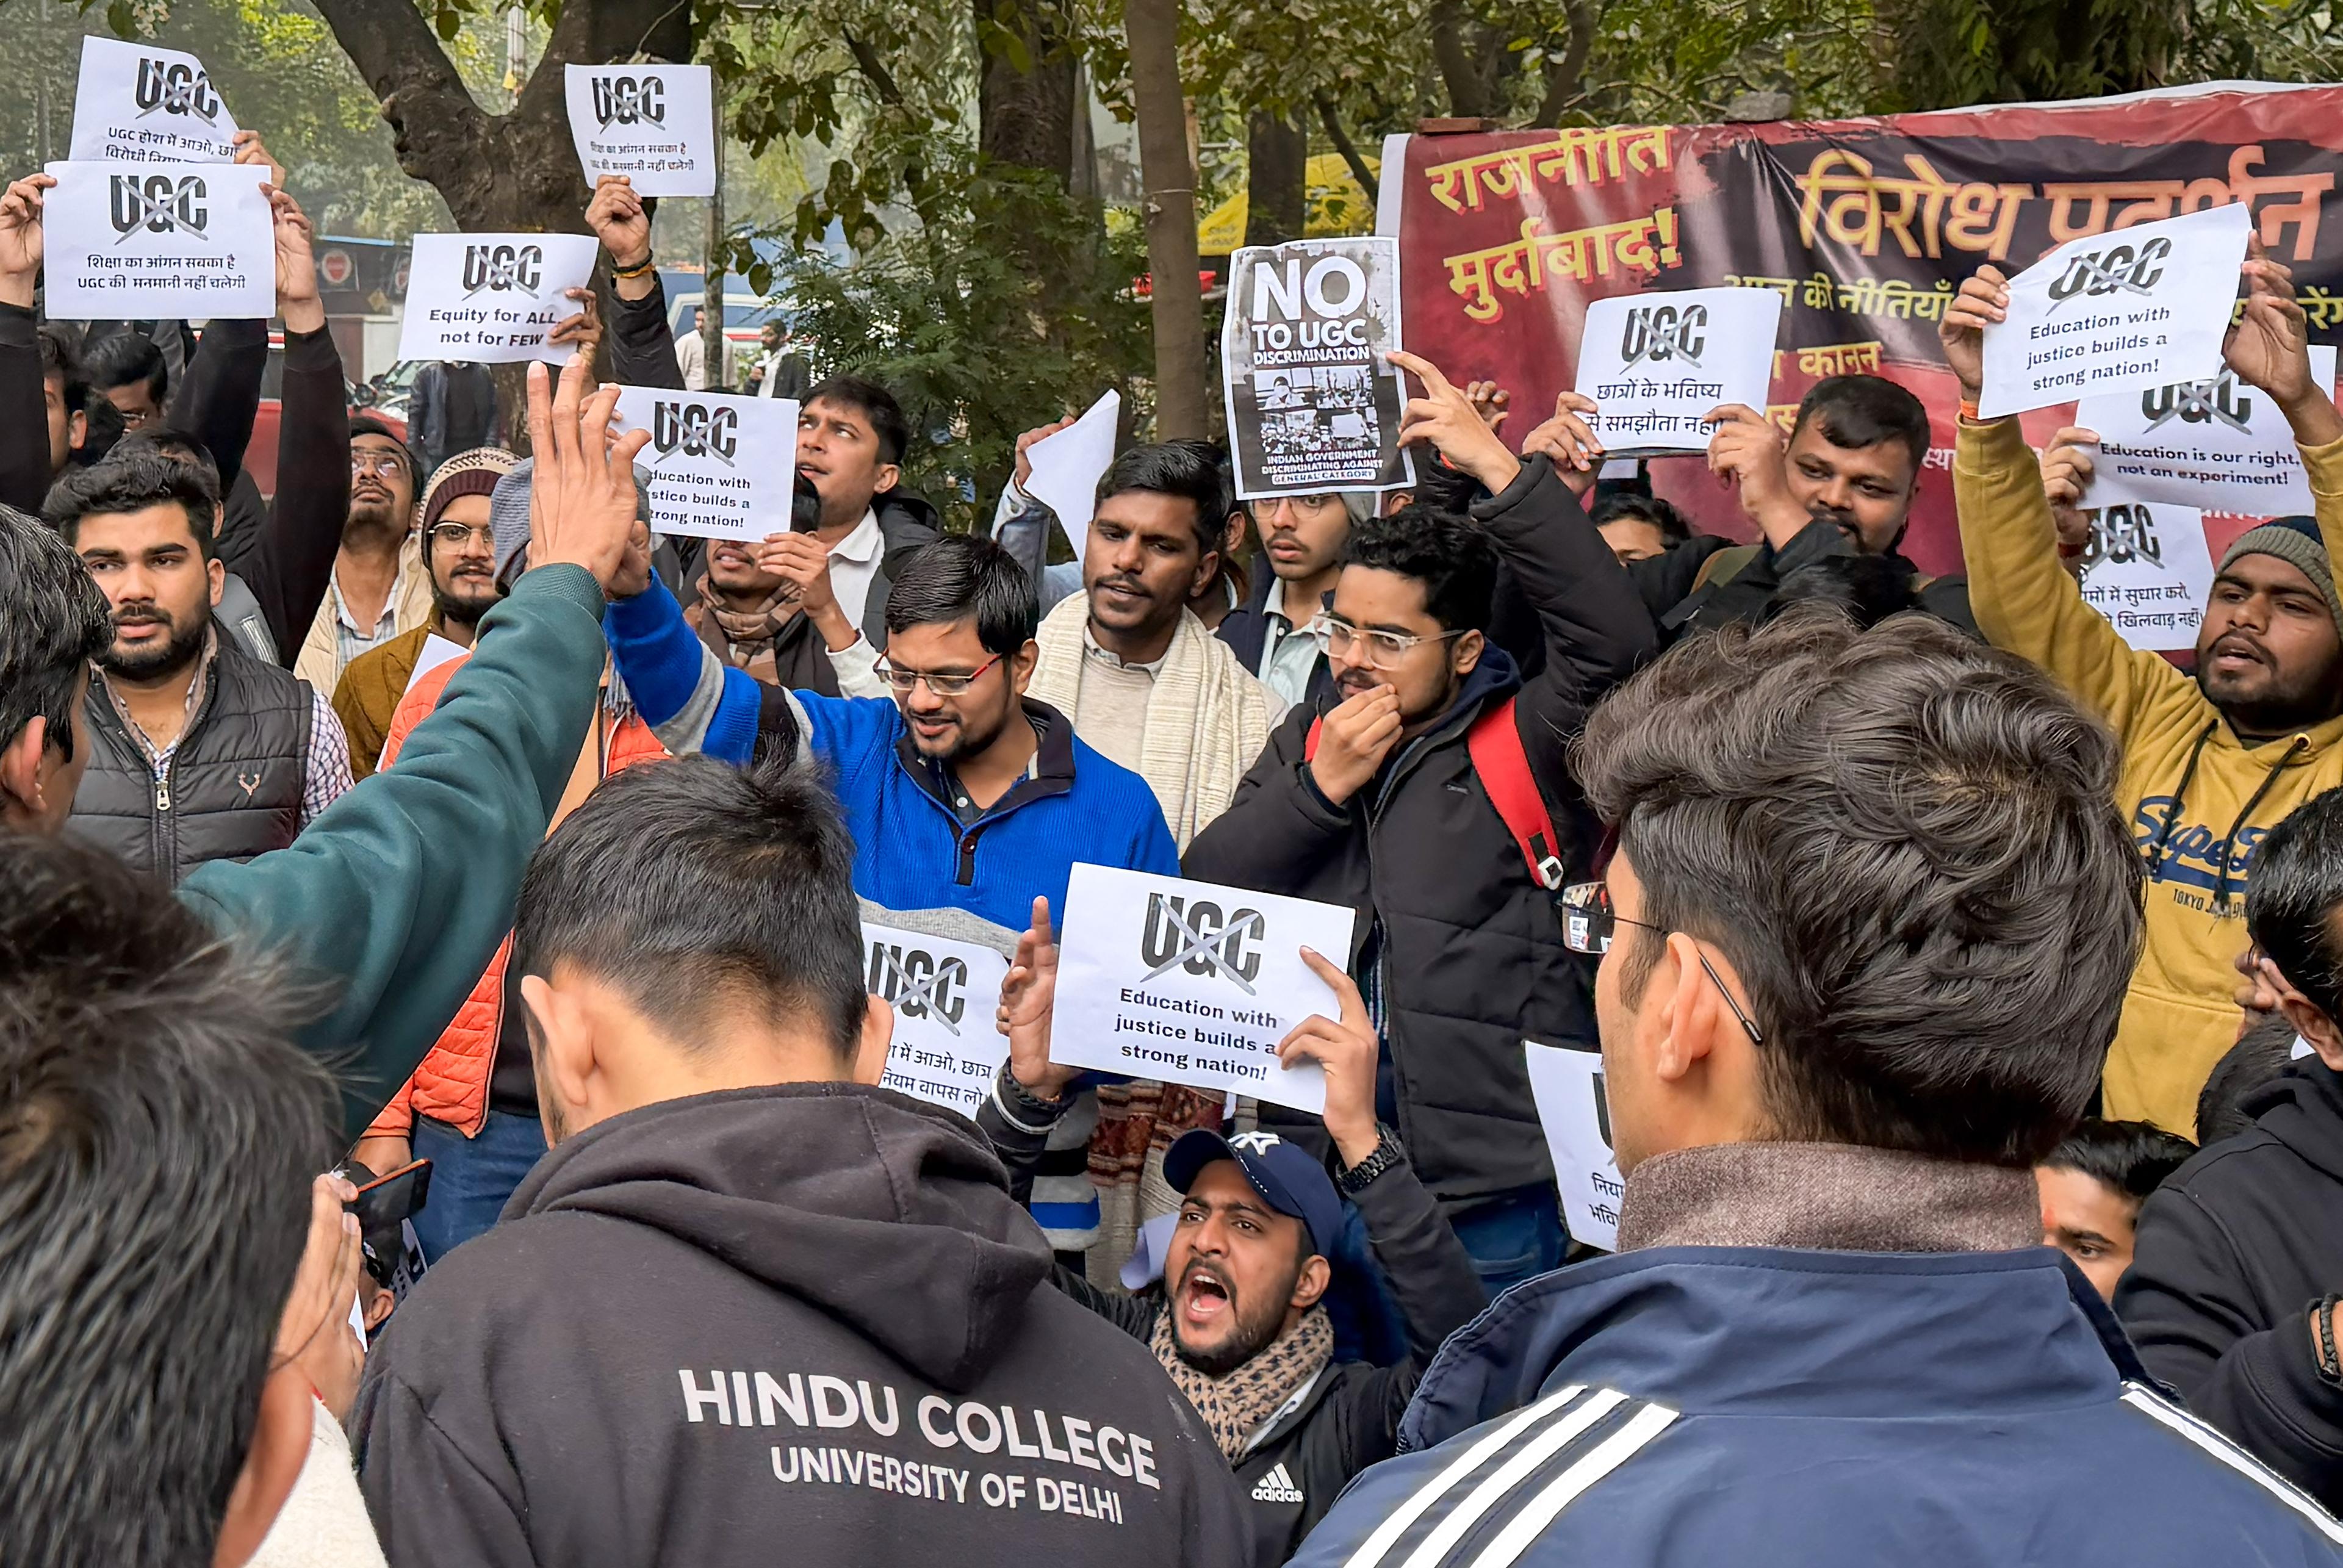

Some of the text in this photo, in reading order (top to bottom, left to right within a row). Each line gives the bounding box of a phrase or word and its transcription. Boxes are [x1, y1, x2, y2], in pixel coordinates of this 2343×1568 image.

[135, 58, 218, 119] UGC
[592, 76, 665, 125] UGC
[109, 126, 135, 141] UGC
[139, 129, 164, 145] होश
[167, 132, 177, 147] में
[179, 137, 214, 156] आओ,
[618, 143, 645, 154] आंगन
[680, 142, 686, 155] है
[647, 159, 665, 172] नहीं
[1425, 124, 1679, 216] राजनीति
[110, 174, 207, 233] UGC
[1795, 148, 2035, 261] विरोध
[87, 254, 121, 269] शिक्षा
[124, 257, 143, 268] का
[146, 254, 181, 268] आंगन
[228, 253, 236, 269] है
[463, 245, 542, 292] UGC
[1442, 206, 1684, 325] मुर्दाबाद!
[2048, 237, 2172, 300] UGC
[78, 274, 245, 290] UGC की मनमानी नहीं चलेगी
[1252, 255, 1367, 322] NO
[1803, 272, 1834, 311] की
[1837, 278, 1954, 322] नीतियाँ
[430, 307, 488, 323] Equity
[494, 308, 520, 322] for
[2030, 307, 2170, 340] Education with
[440, 331, 544, 347] not for FEW
[1251, 318, 1367, 351] TO UGC
[1621, 304, 1707, 362] UGC
[1253, 345, 1370, 366] DISCRIMINATION
[2026, 334, 2167, 370] justice builds a
[1597, 378, 1723, 400] छात्रों के भविष्य
[2033, 359, 2159, 390] strong nation!
[654, 401, 737, 459] UGC
[1606, 408, 1679, 436] समझौता
[1684, 417, 1722, 436] नह
[1267, 449, 1378, 465] INDIAN GOVERNMENT
[1342, 459, 1384, 470] AGAINST
[2101, 443, 2300, 468] Education is our right,
[652, 470, 751, 489] ducation with
[2117, 463, 2288, 485] not an experiment!
[650, 490, 750, 509] stice builds a
[650, 509, 744, 528] trong nation!
[2110, 585, 2120, 602] में
[2125, 586, 2161, 607] सुधार
[2173, 888, 2204, 911] TOKYO
[1142, 893, 1265, 983] UGC
[868, 941, 968, 1026] UGC
[1120, 988, 1277, 1029] Education with
[1114, 1013, 1276, 1054] justice builds a
[900, 1041, 912, 1062] में
[913, 1050, 956, 1074] आओ,
[961, 1060, 992, 1079] छात्र
[1121, 1045, 1267, 1081] strong nation!
[919, 1079, 960, 1101] वापस
[1588, 1203, 1619, 1228] भवि
[678, 1369, 1161, 1489] HINDU COLLEGE
[771, 1446, 1123, 1525] UNIVERSITY OF DELHI
[1251, 1486, 1304, 1503] adidas
